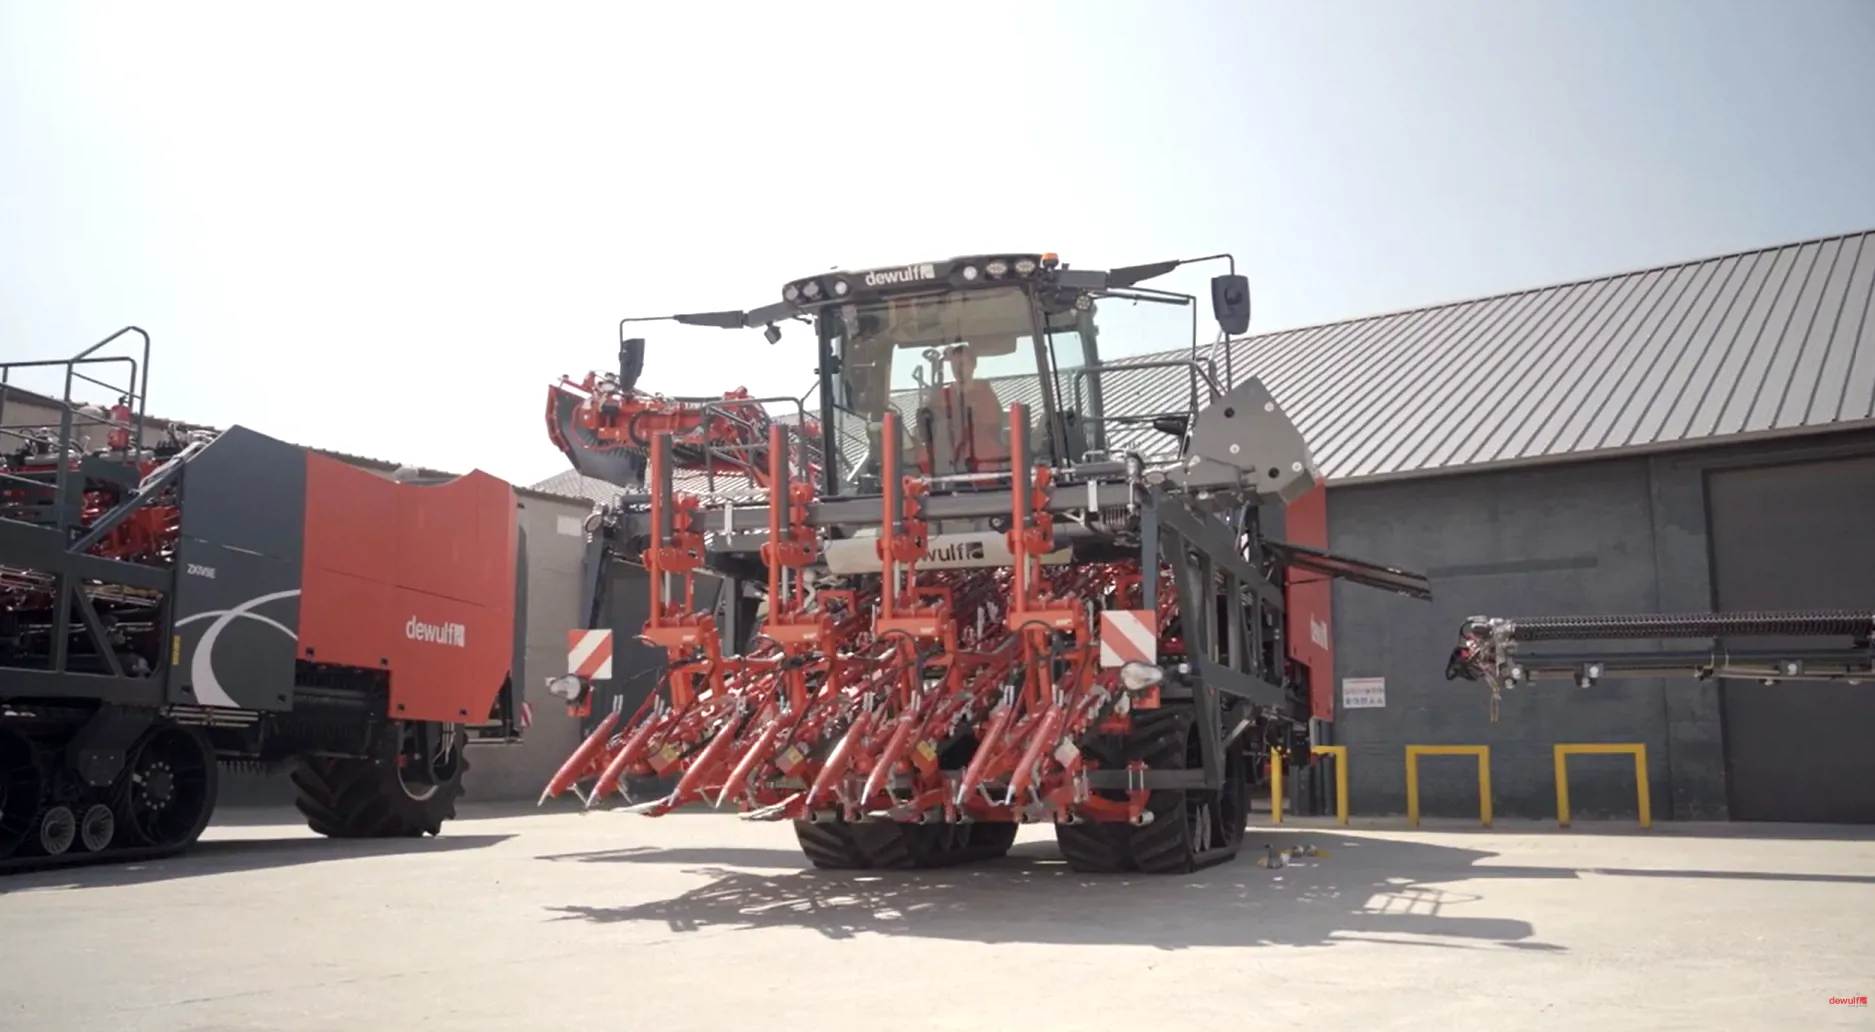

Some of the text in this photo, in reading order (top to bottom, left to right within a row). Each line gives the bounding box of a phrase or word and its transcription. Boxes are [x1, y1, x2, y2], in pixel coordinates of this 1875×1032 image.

[865, 265, 919, 286] dewulf
[924, 543, 964, 562] wulf
[406, 614, 454, 645] dewulf
